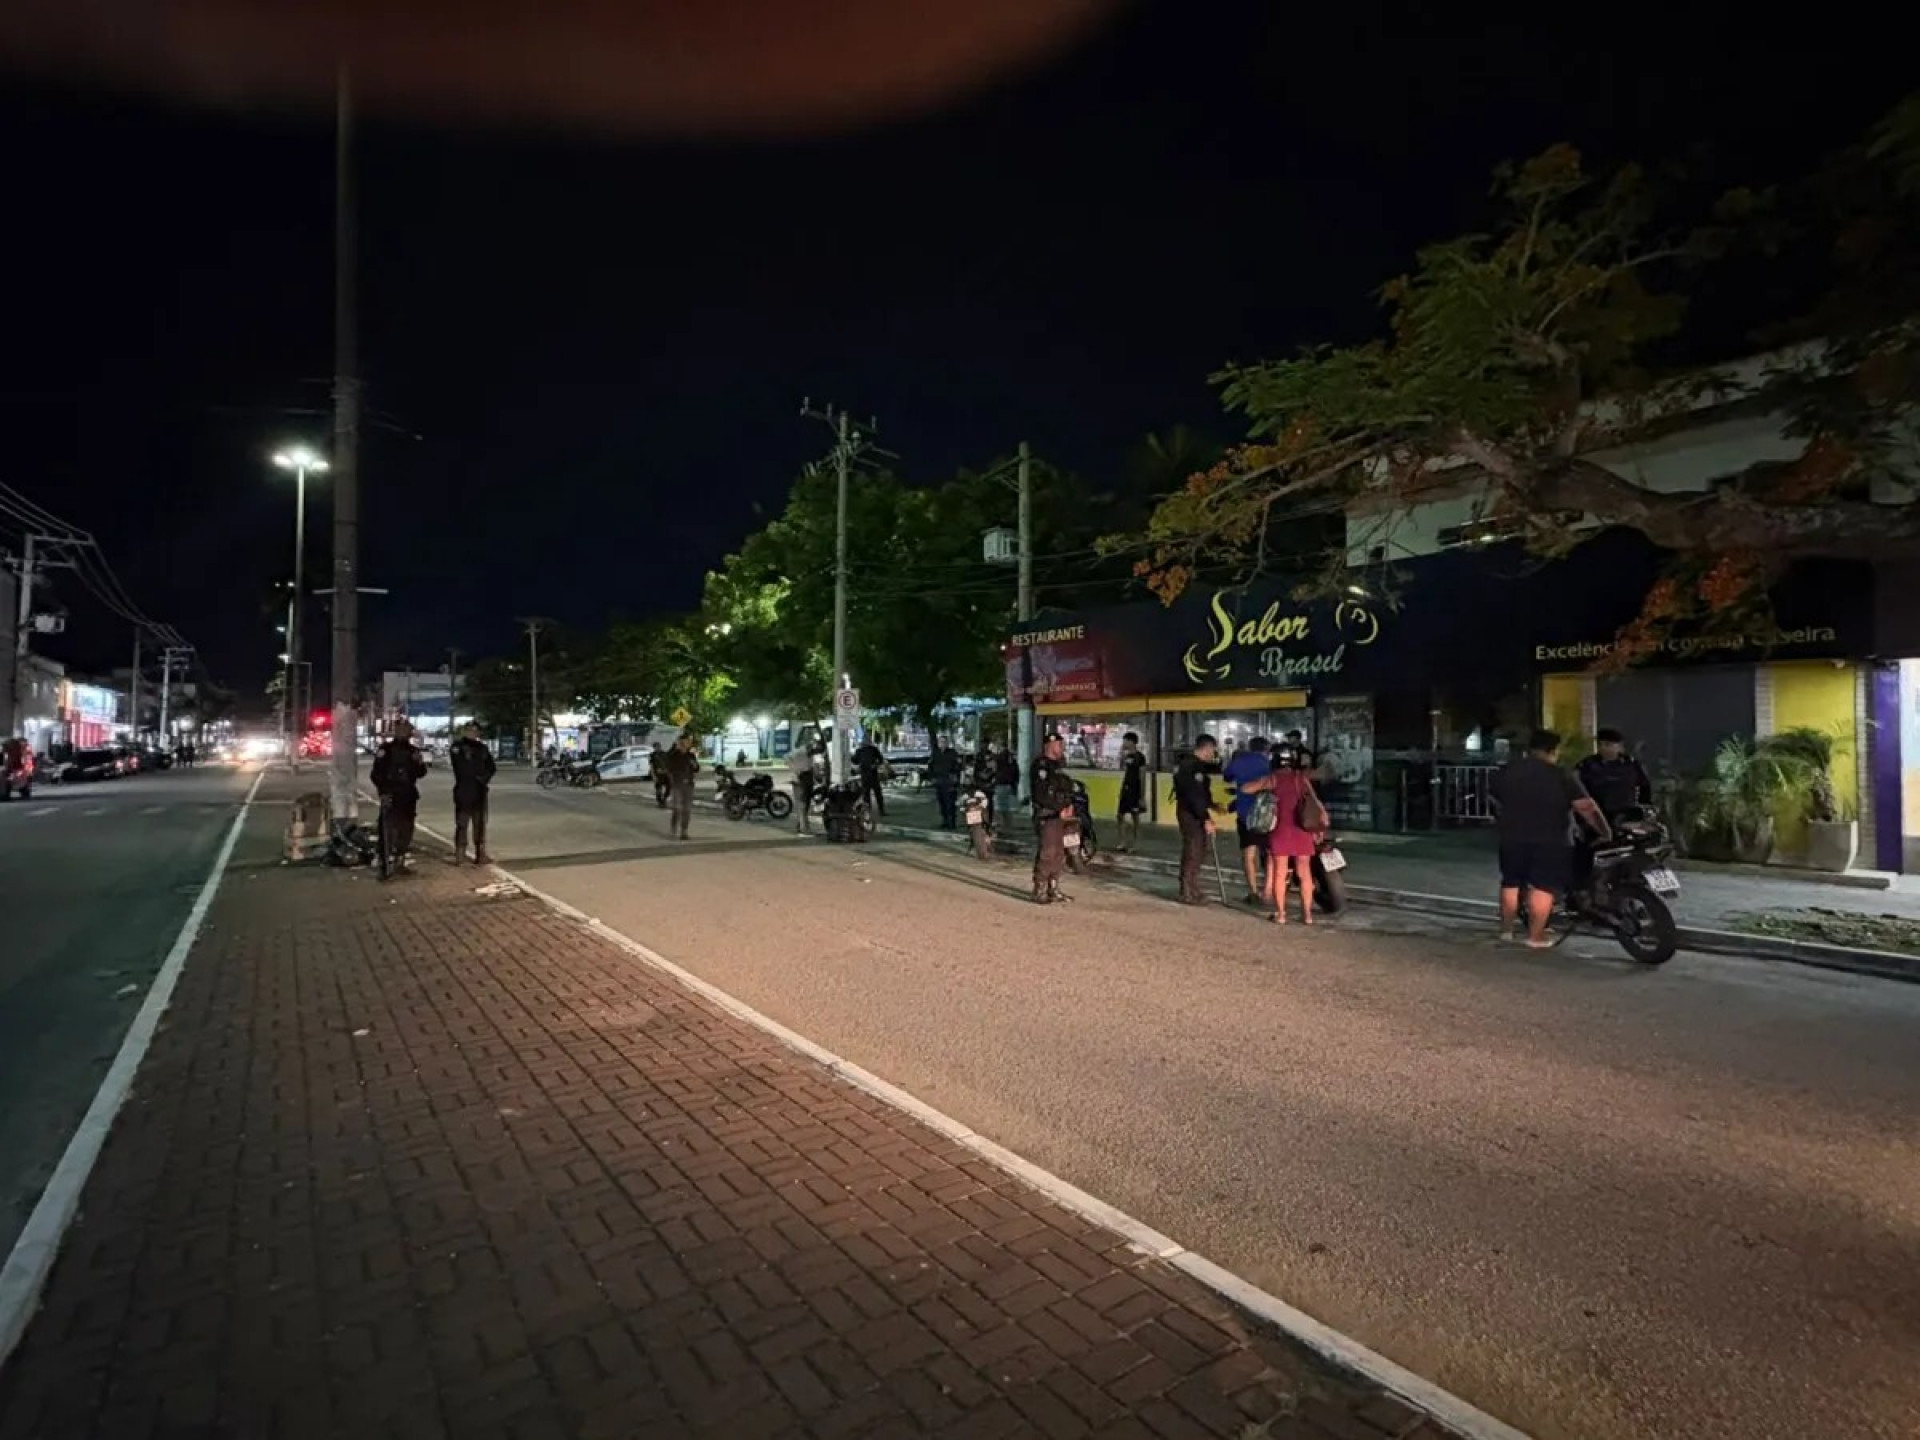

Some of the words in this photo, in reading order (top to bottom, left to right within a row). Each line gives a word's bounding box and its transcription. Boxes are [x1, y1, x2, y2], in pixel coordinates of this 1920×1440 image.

[1012, 625, 1085, 646] RESTAURANTE
[1208, 590, 1310, 660] Sabor
[1536, 637, 1630, 660] Excelênci
[1751, 625, 1837, 645] Cseira
[1259, 643, 1345, 677] Brasil
